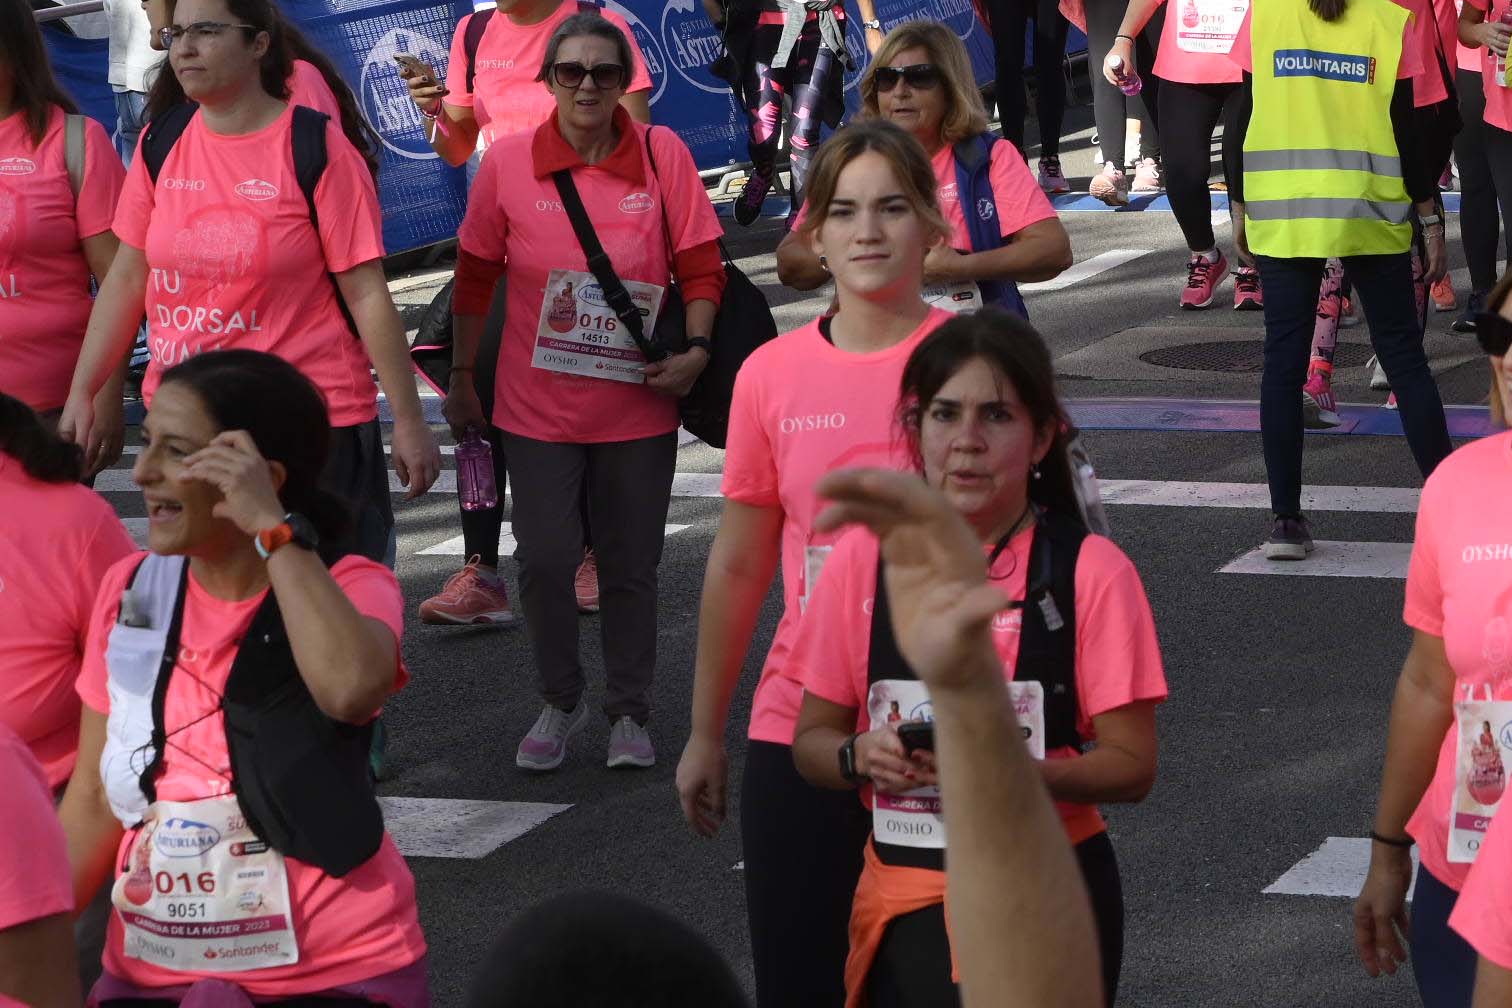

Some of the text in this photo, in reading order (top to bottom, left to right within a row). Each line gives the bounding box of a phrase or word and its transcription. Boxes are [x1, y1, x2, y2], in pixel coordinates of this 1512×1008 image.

[478, 58, 514, 71] OYSHO
[1275, 56, 1366, 76] VOLUNTARIS
[164, 177, 206, 192] OYSHO
[152, 268, 182, 293] TU
[157, 303, 262, 335] DORSAL
[579, 313, 617, 332] 016
[581, 332, 610, 345] 14513
[550, 341, 580, 352] CARRERA
[591, 347, 600, 355] LA
[600, 348, 623, 358] MUJER
[544, 353, 578, 367] OYSHO
[780, 412, 846, 434] OYSHO
[886, 819, 933, 835] OYSHO
[155, 871, 216, 894] 016
[167, 903, 207, 918] 9051
[170, 925, 185, 935] DE
[186, 925, 200, 935] LA
[202, 923, 240, 935] MUJER
[218, 942, 280, 960] Santander
